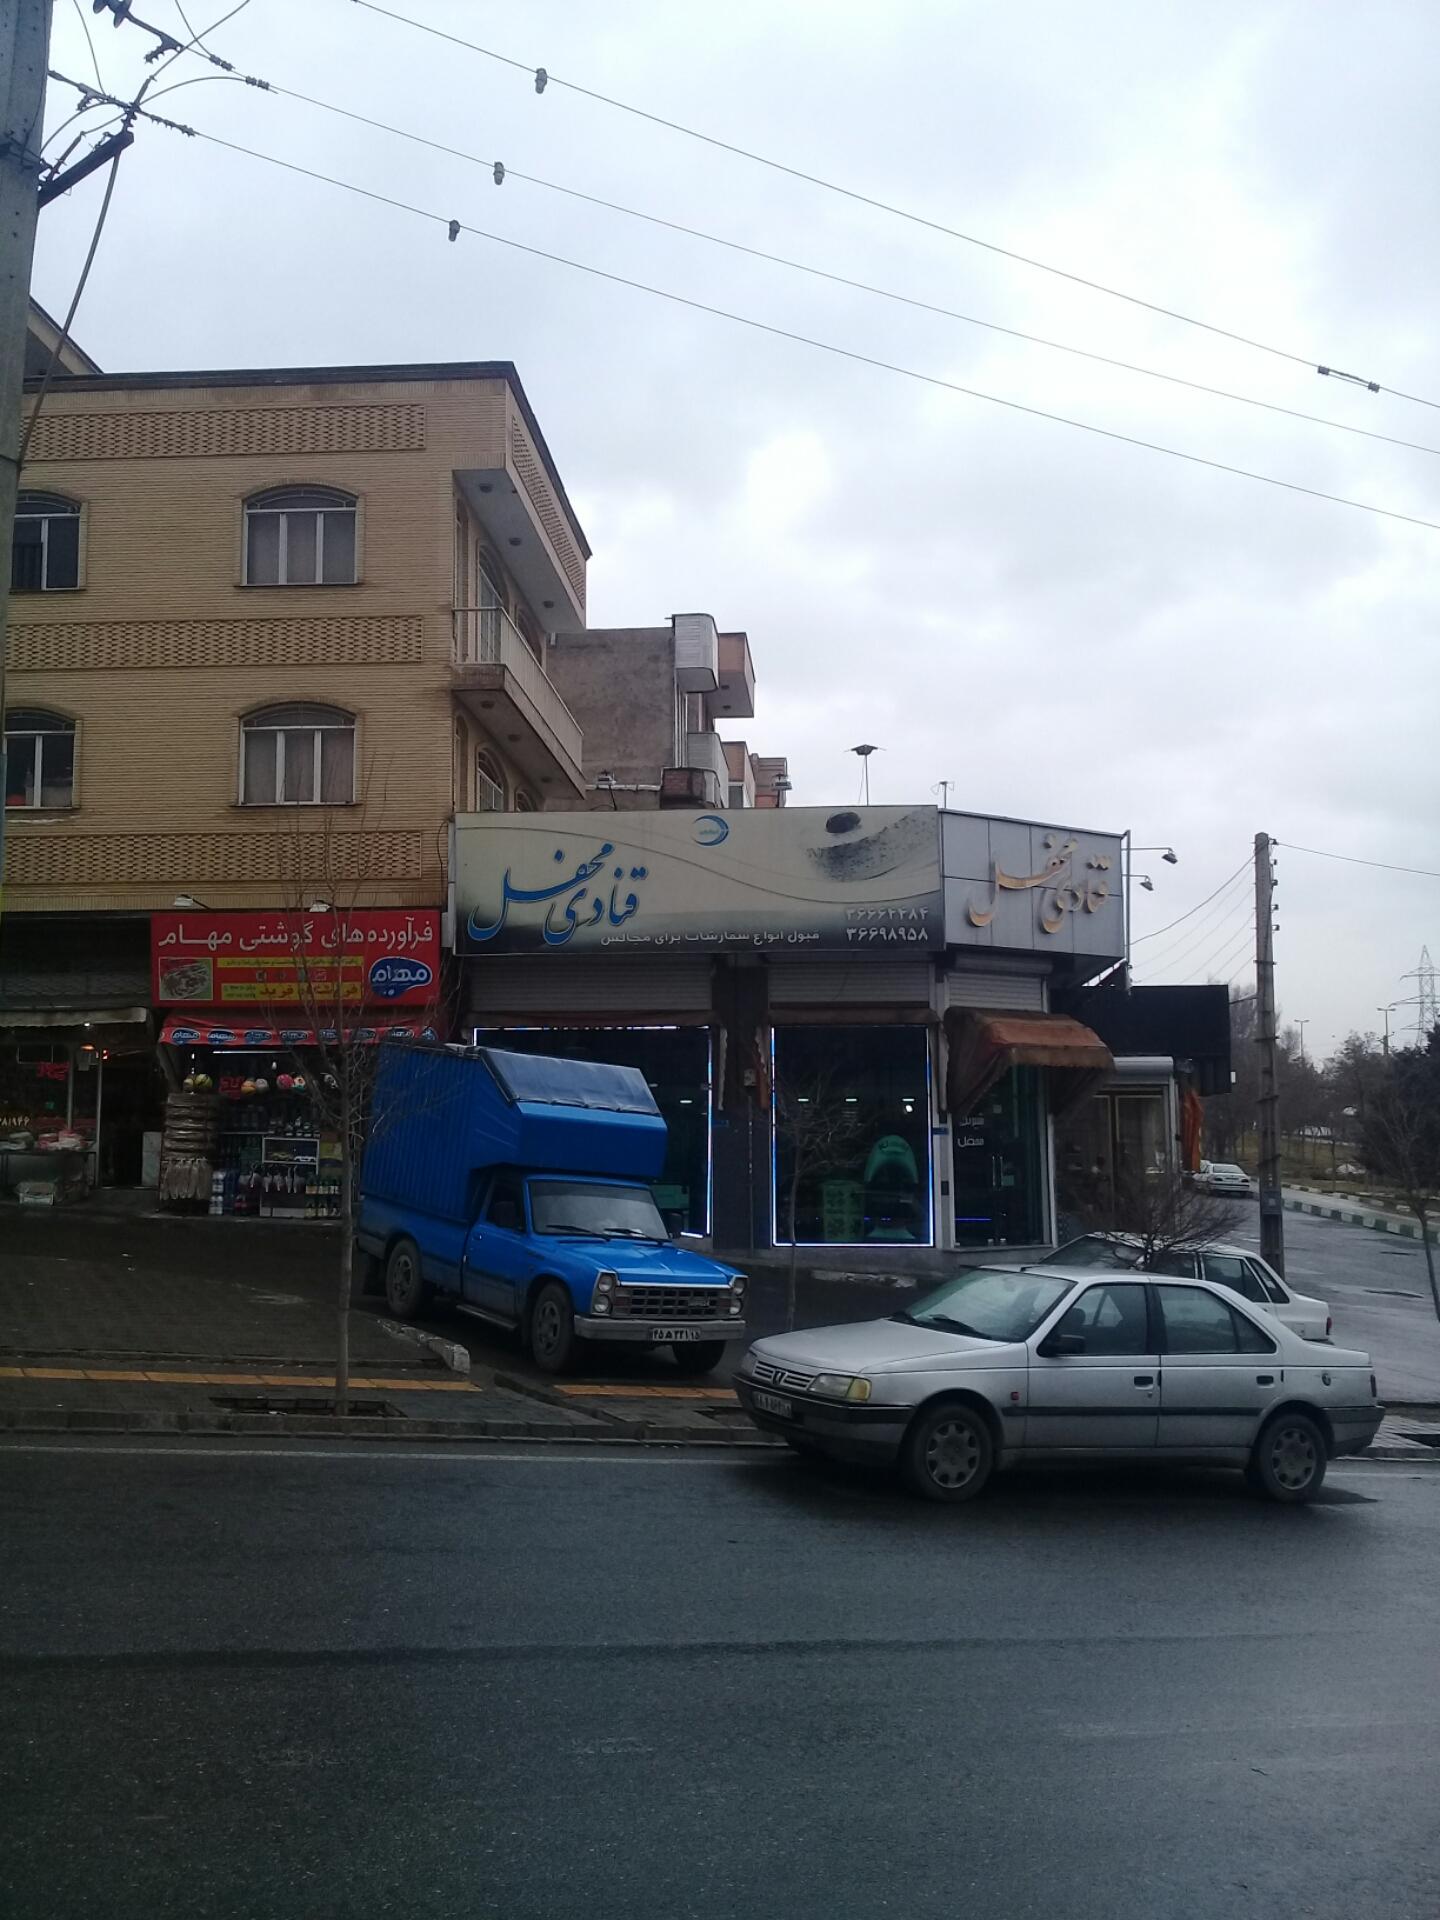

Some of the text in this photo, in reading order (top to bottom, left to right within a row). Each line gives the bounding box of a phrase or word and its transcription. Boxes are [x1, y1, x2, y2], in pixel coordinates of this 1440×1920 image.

[467, 842, 614, 942] محفل
[158, 923, 233, 952] مهام
[239, 920, 315, 953] گوشتی
[600, 930, 820, 947] قبول انواع سفارشات برای مجالس
[846, 926, 929, 941] ۳۶۶۹۸۹۵۸
[371, 964, 428, 983] مهام
